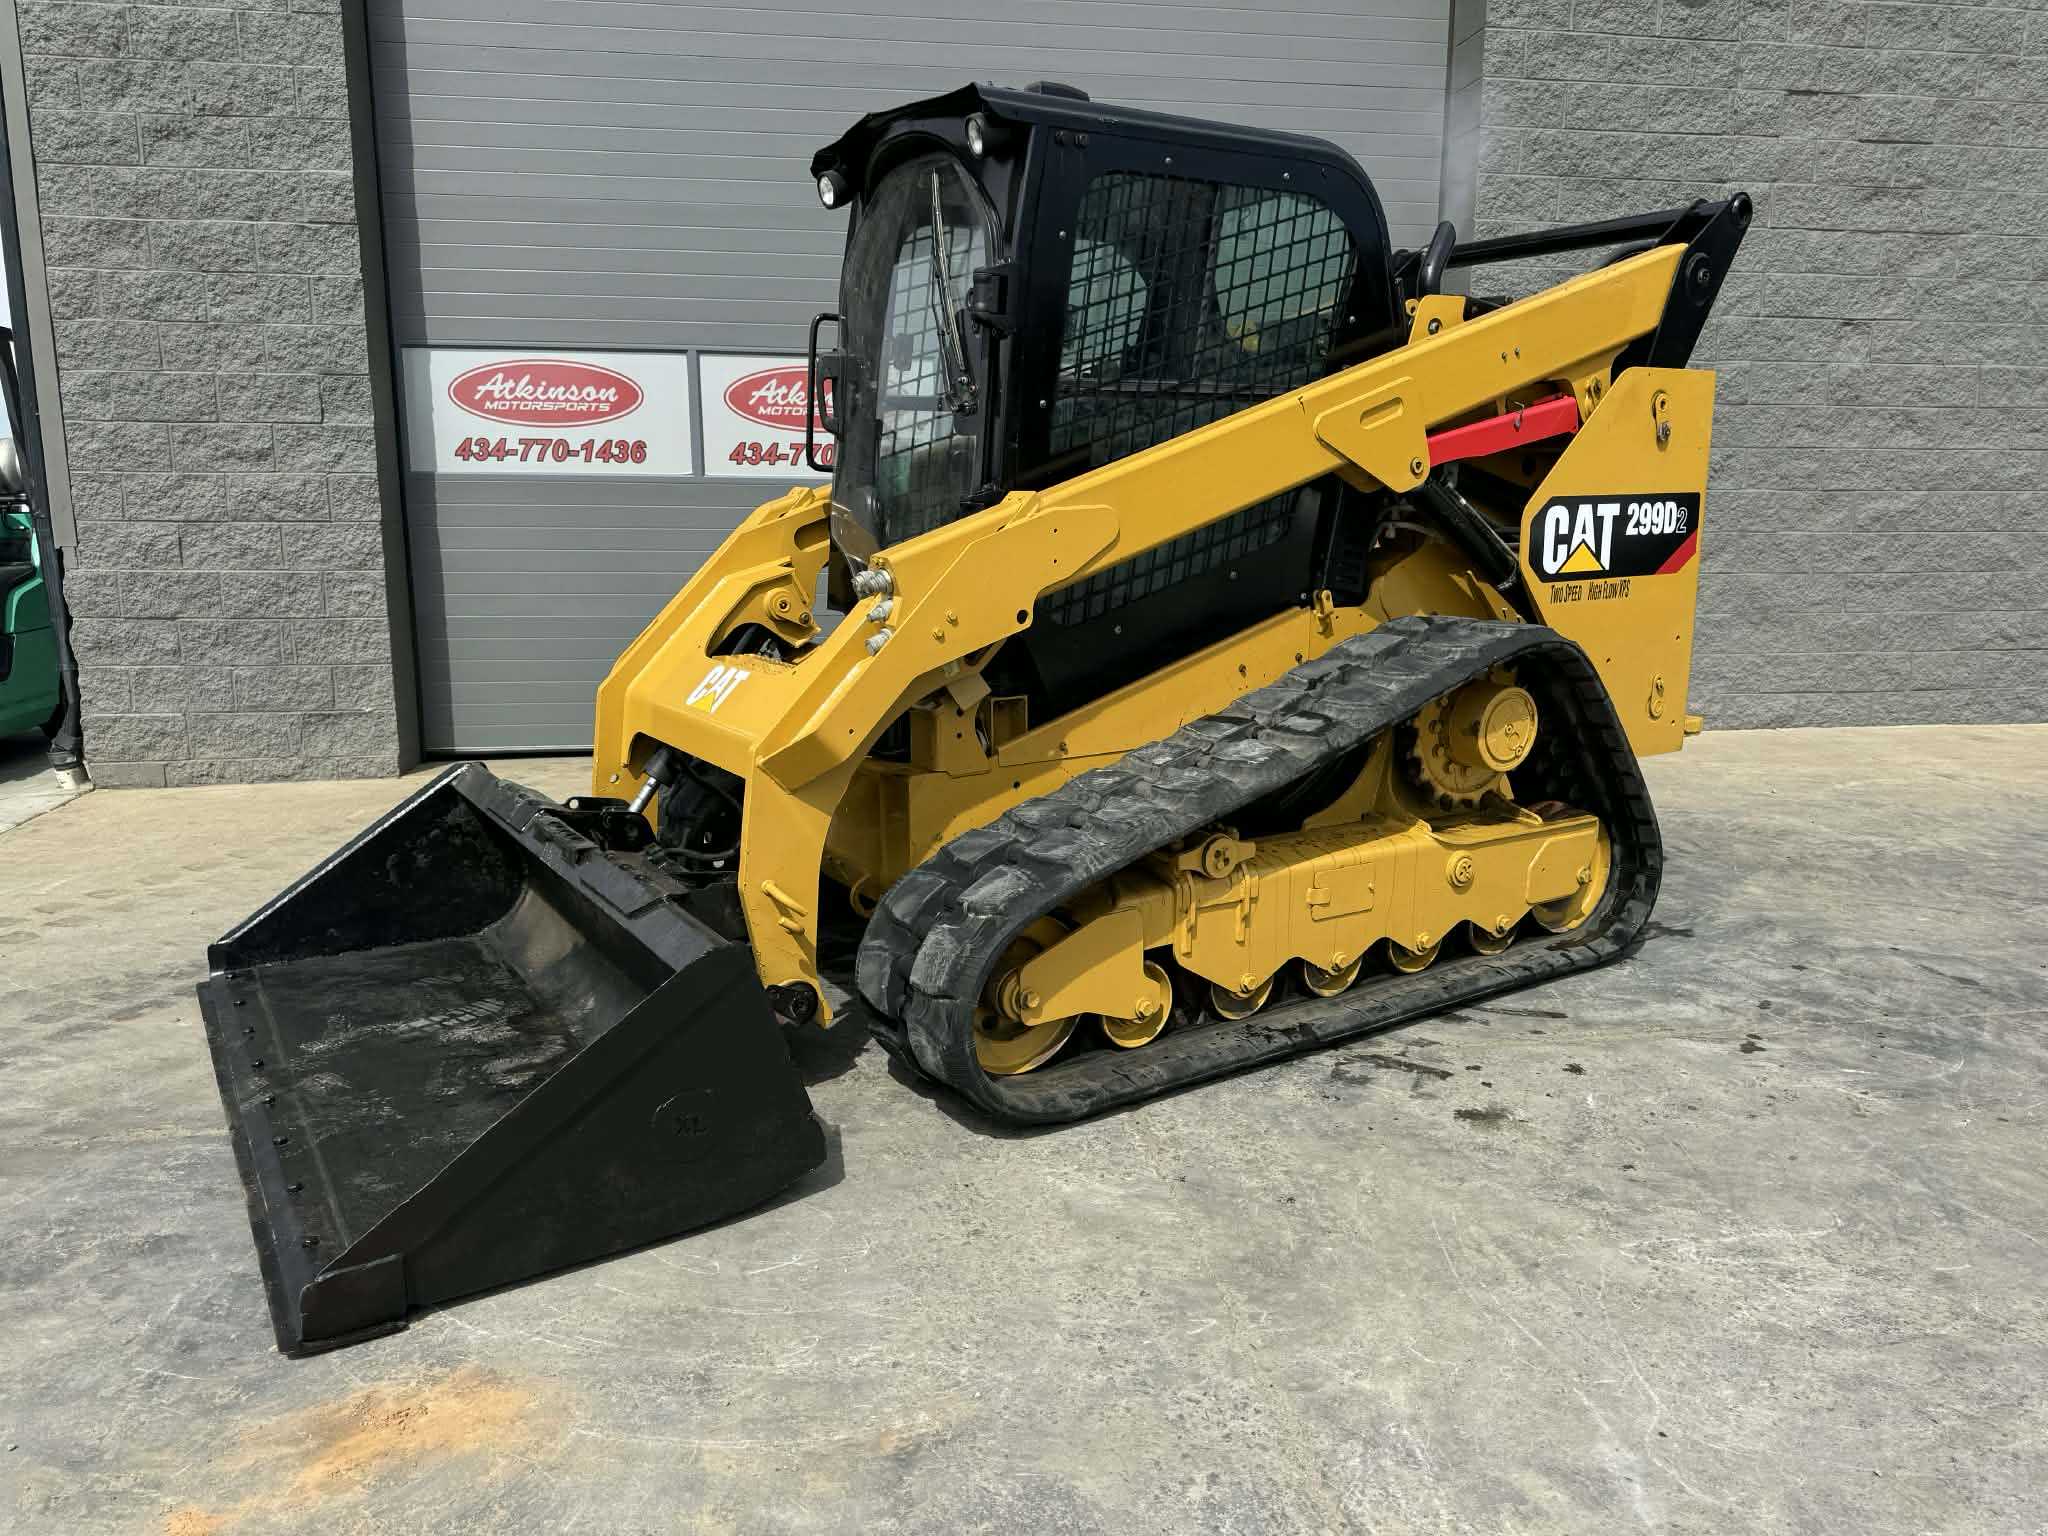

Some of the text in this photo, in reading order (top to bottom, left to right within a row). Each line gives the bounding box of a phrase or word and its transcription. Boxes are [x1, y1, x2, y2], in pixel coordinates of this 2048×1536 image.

[474, 372, 619, 402] Atkinson
[484, 399, 611, 413] MOTORSPORTS
[454, 437, 647, 465] 434-770-1436
[728, 441, 833, 467] 434-770
[1542, 503, 1621, 575] CAT
[685, 664, 751, 714] CAT
